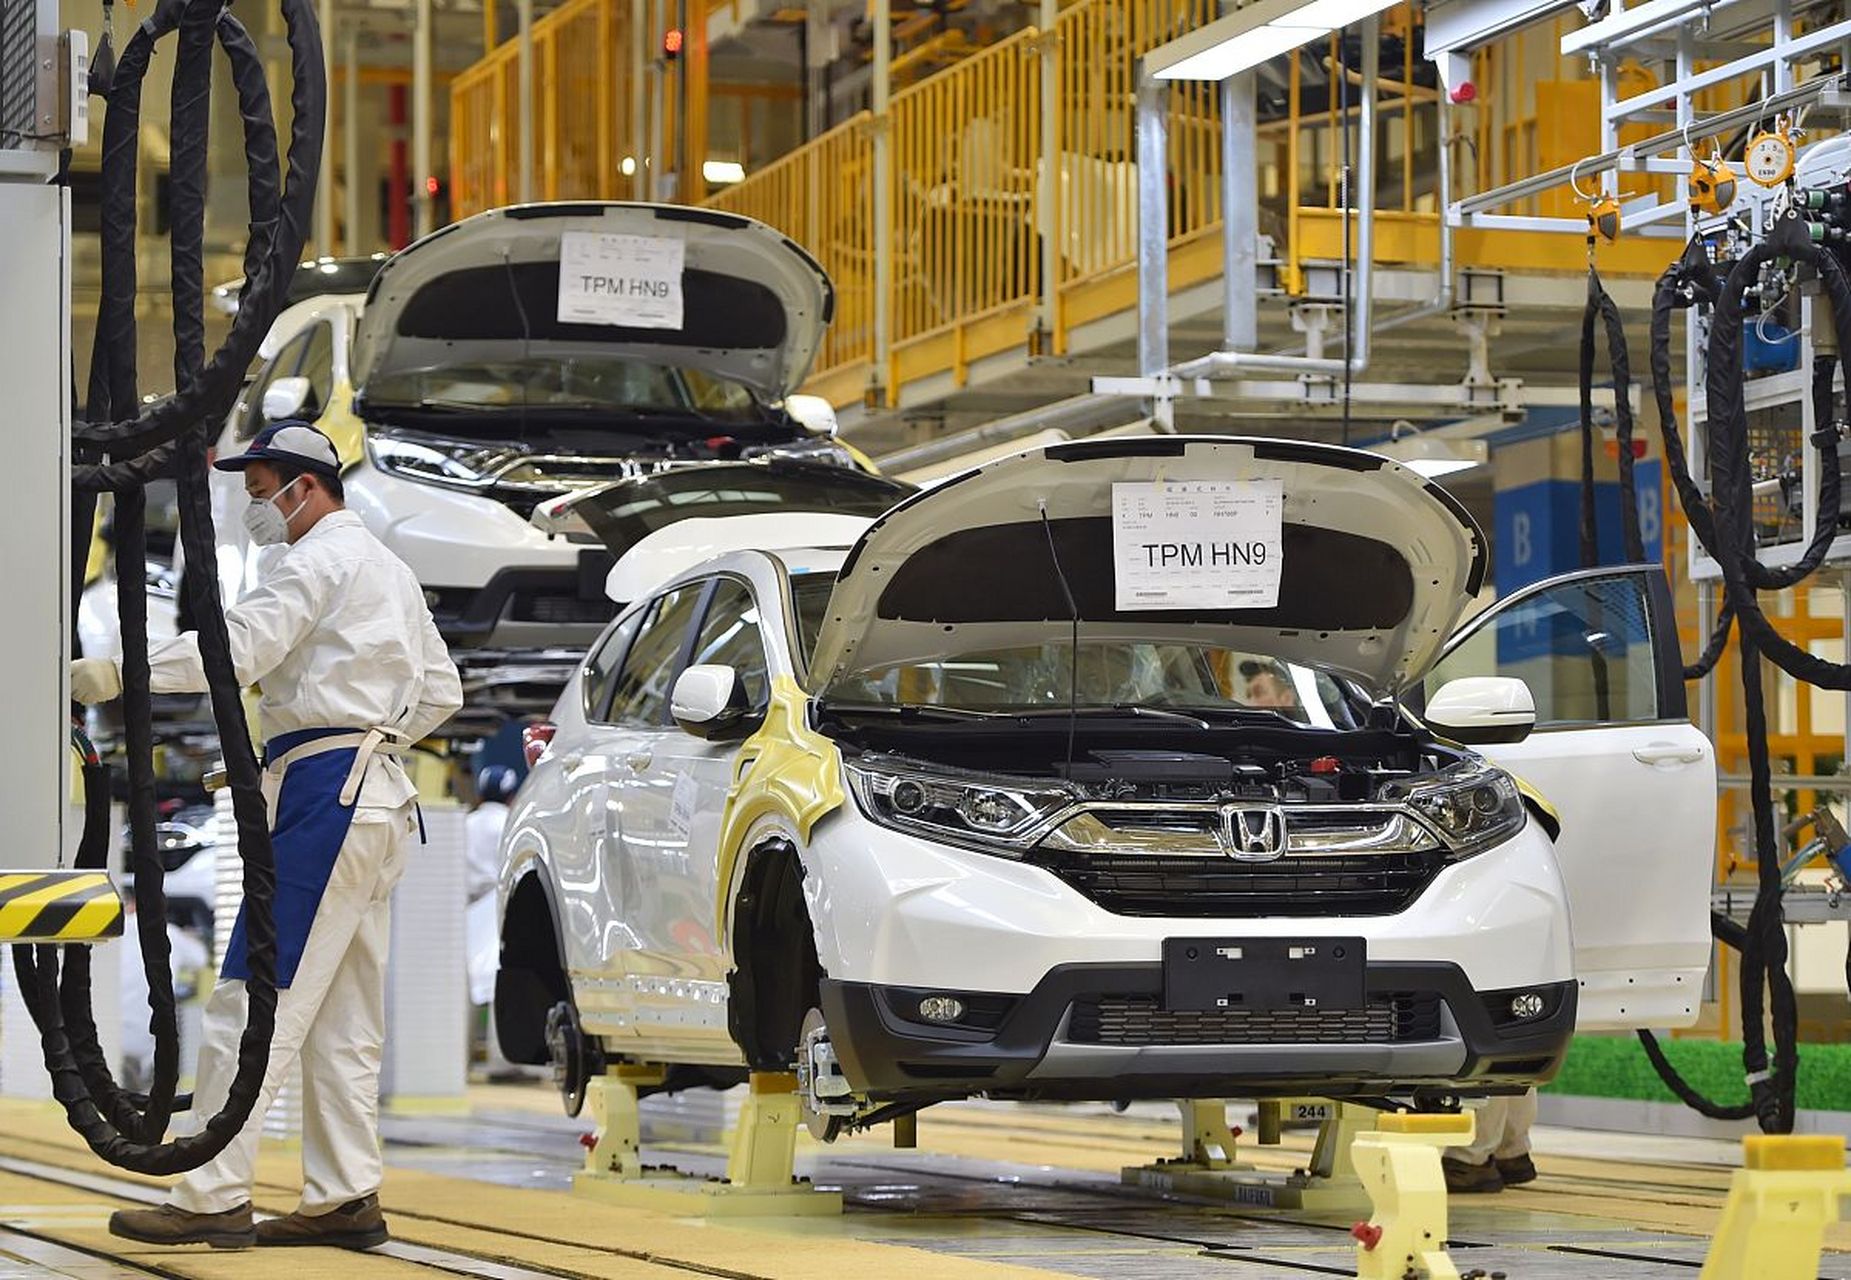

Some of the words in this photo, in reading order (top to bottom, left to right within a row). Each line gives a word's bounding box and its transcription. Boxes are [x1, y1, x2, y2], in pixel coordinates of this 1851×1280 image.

[580, 275, 623, 295] TPM
[629, 278, 669, 298] HN9
[1639, 488, 1660, 544] B
[1513, 512, 1532, 567] B
[1142, 543, 1203, 568] TPM
[1212, 542, 1266, 566] HN9
[1298, 1105, 1326, 1119] 244
